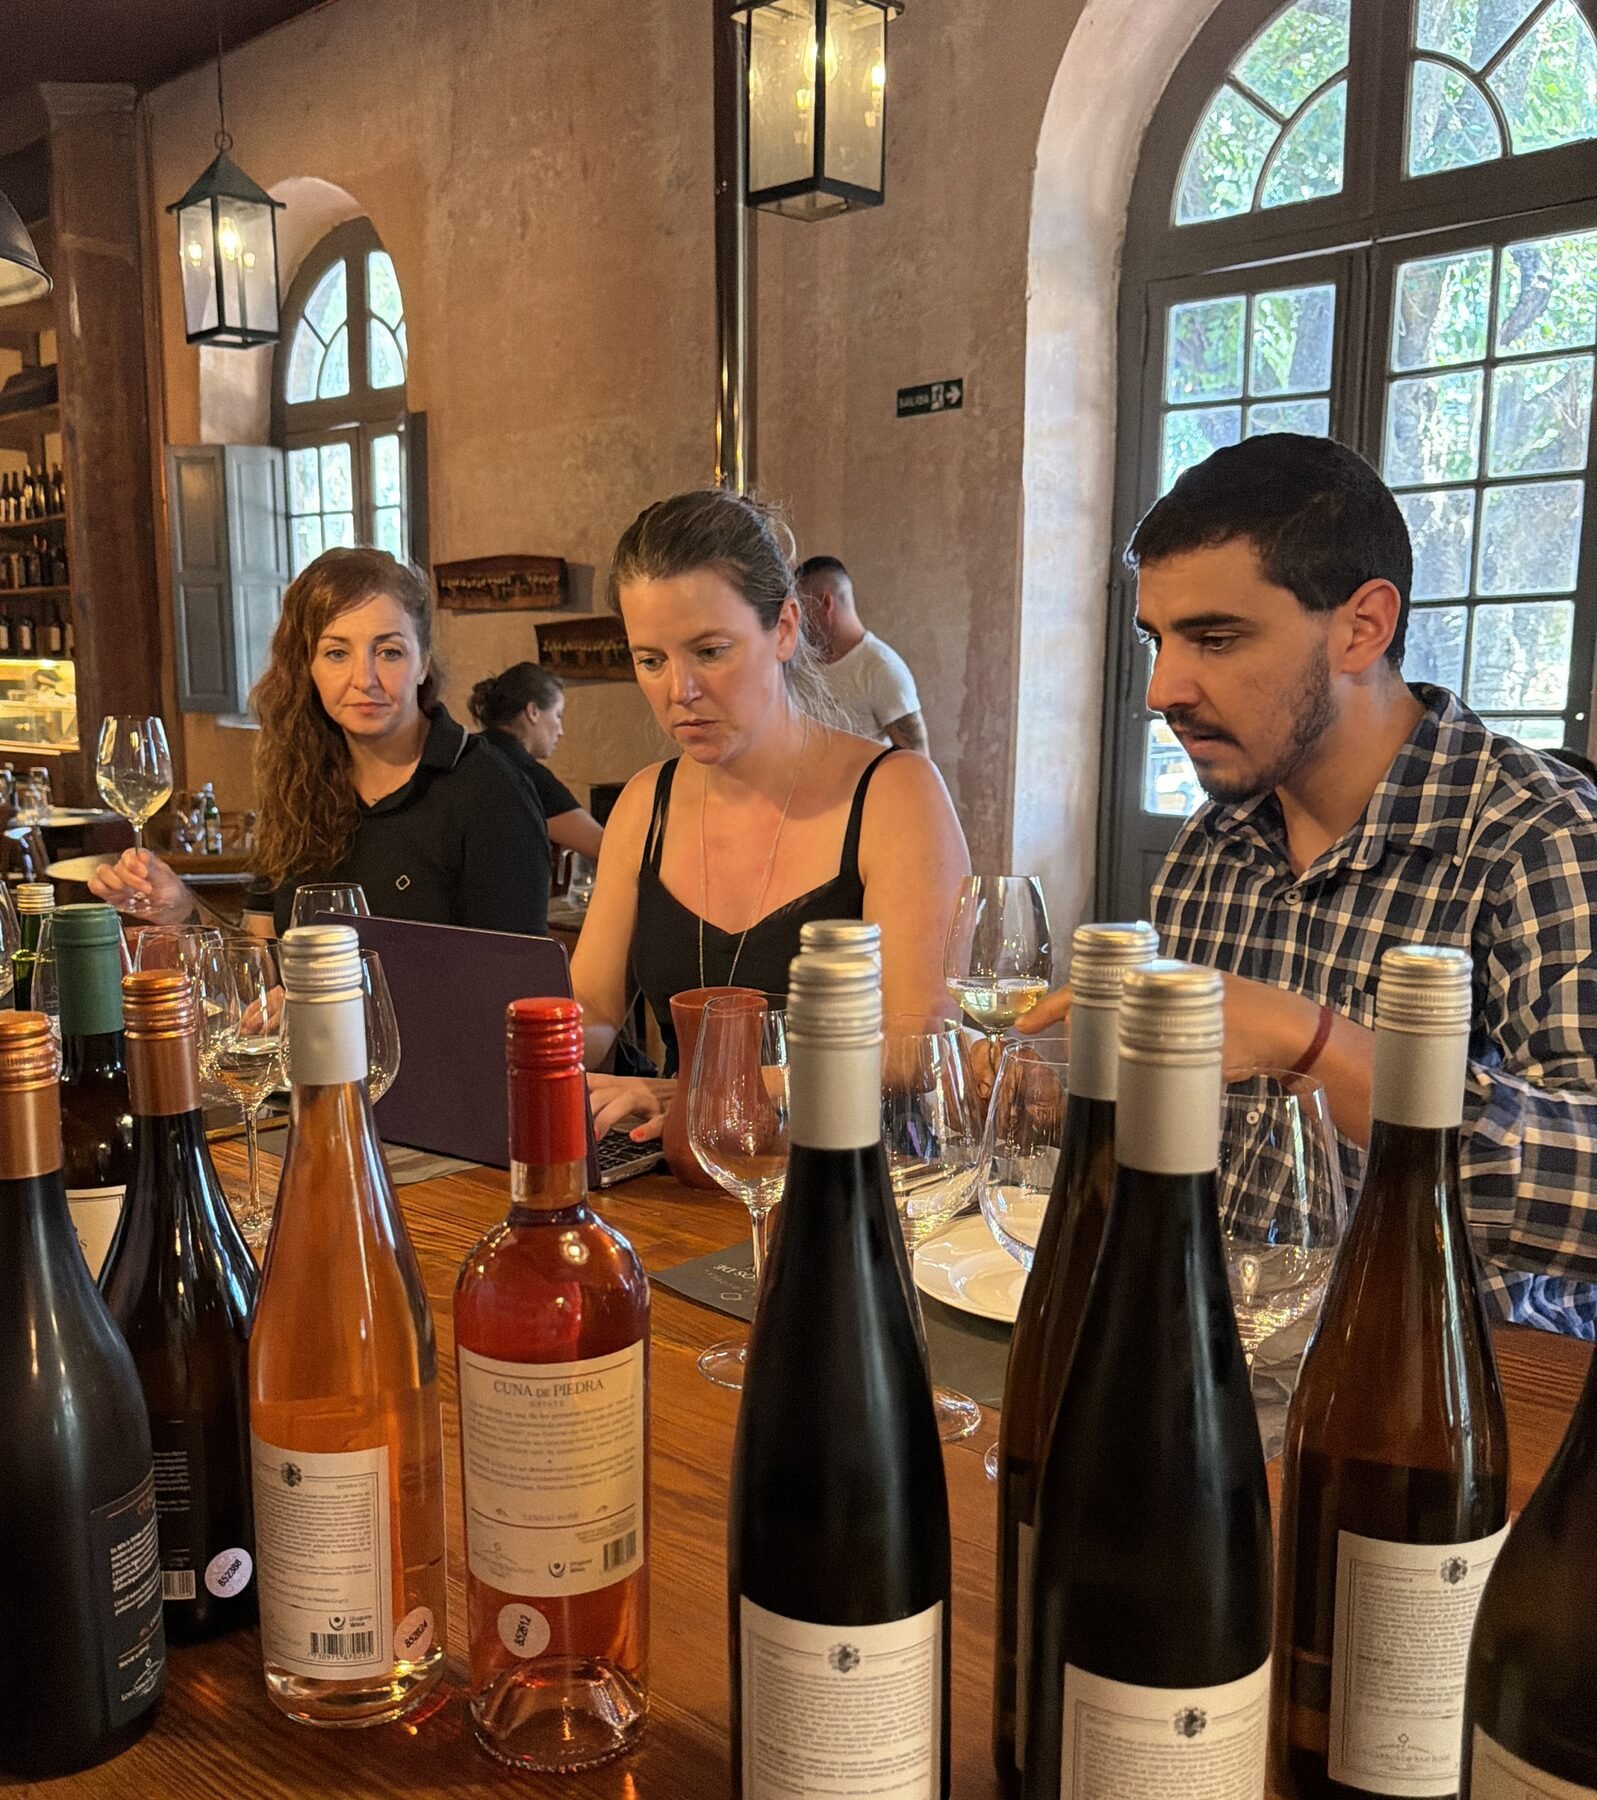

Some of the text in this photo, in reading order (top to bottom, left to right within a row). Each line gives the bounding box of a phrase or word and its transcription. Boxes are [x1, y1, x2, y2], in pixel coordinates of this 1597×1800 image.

[494, 1381, 533, 1396] CUNA
[554, 1379, 604, 1397] PIEDRA
[218, 1558, 242, 1587] 852388
